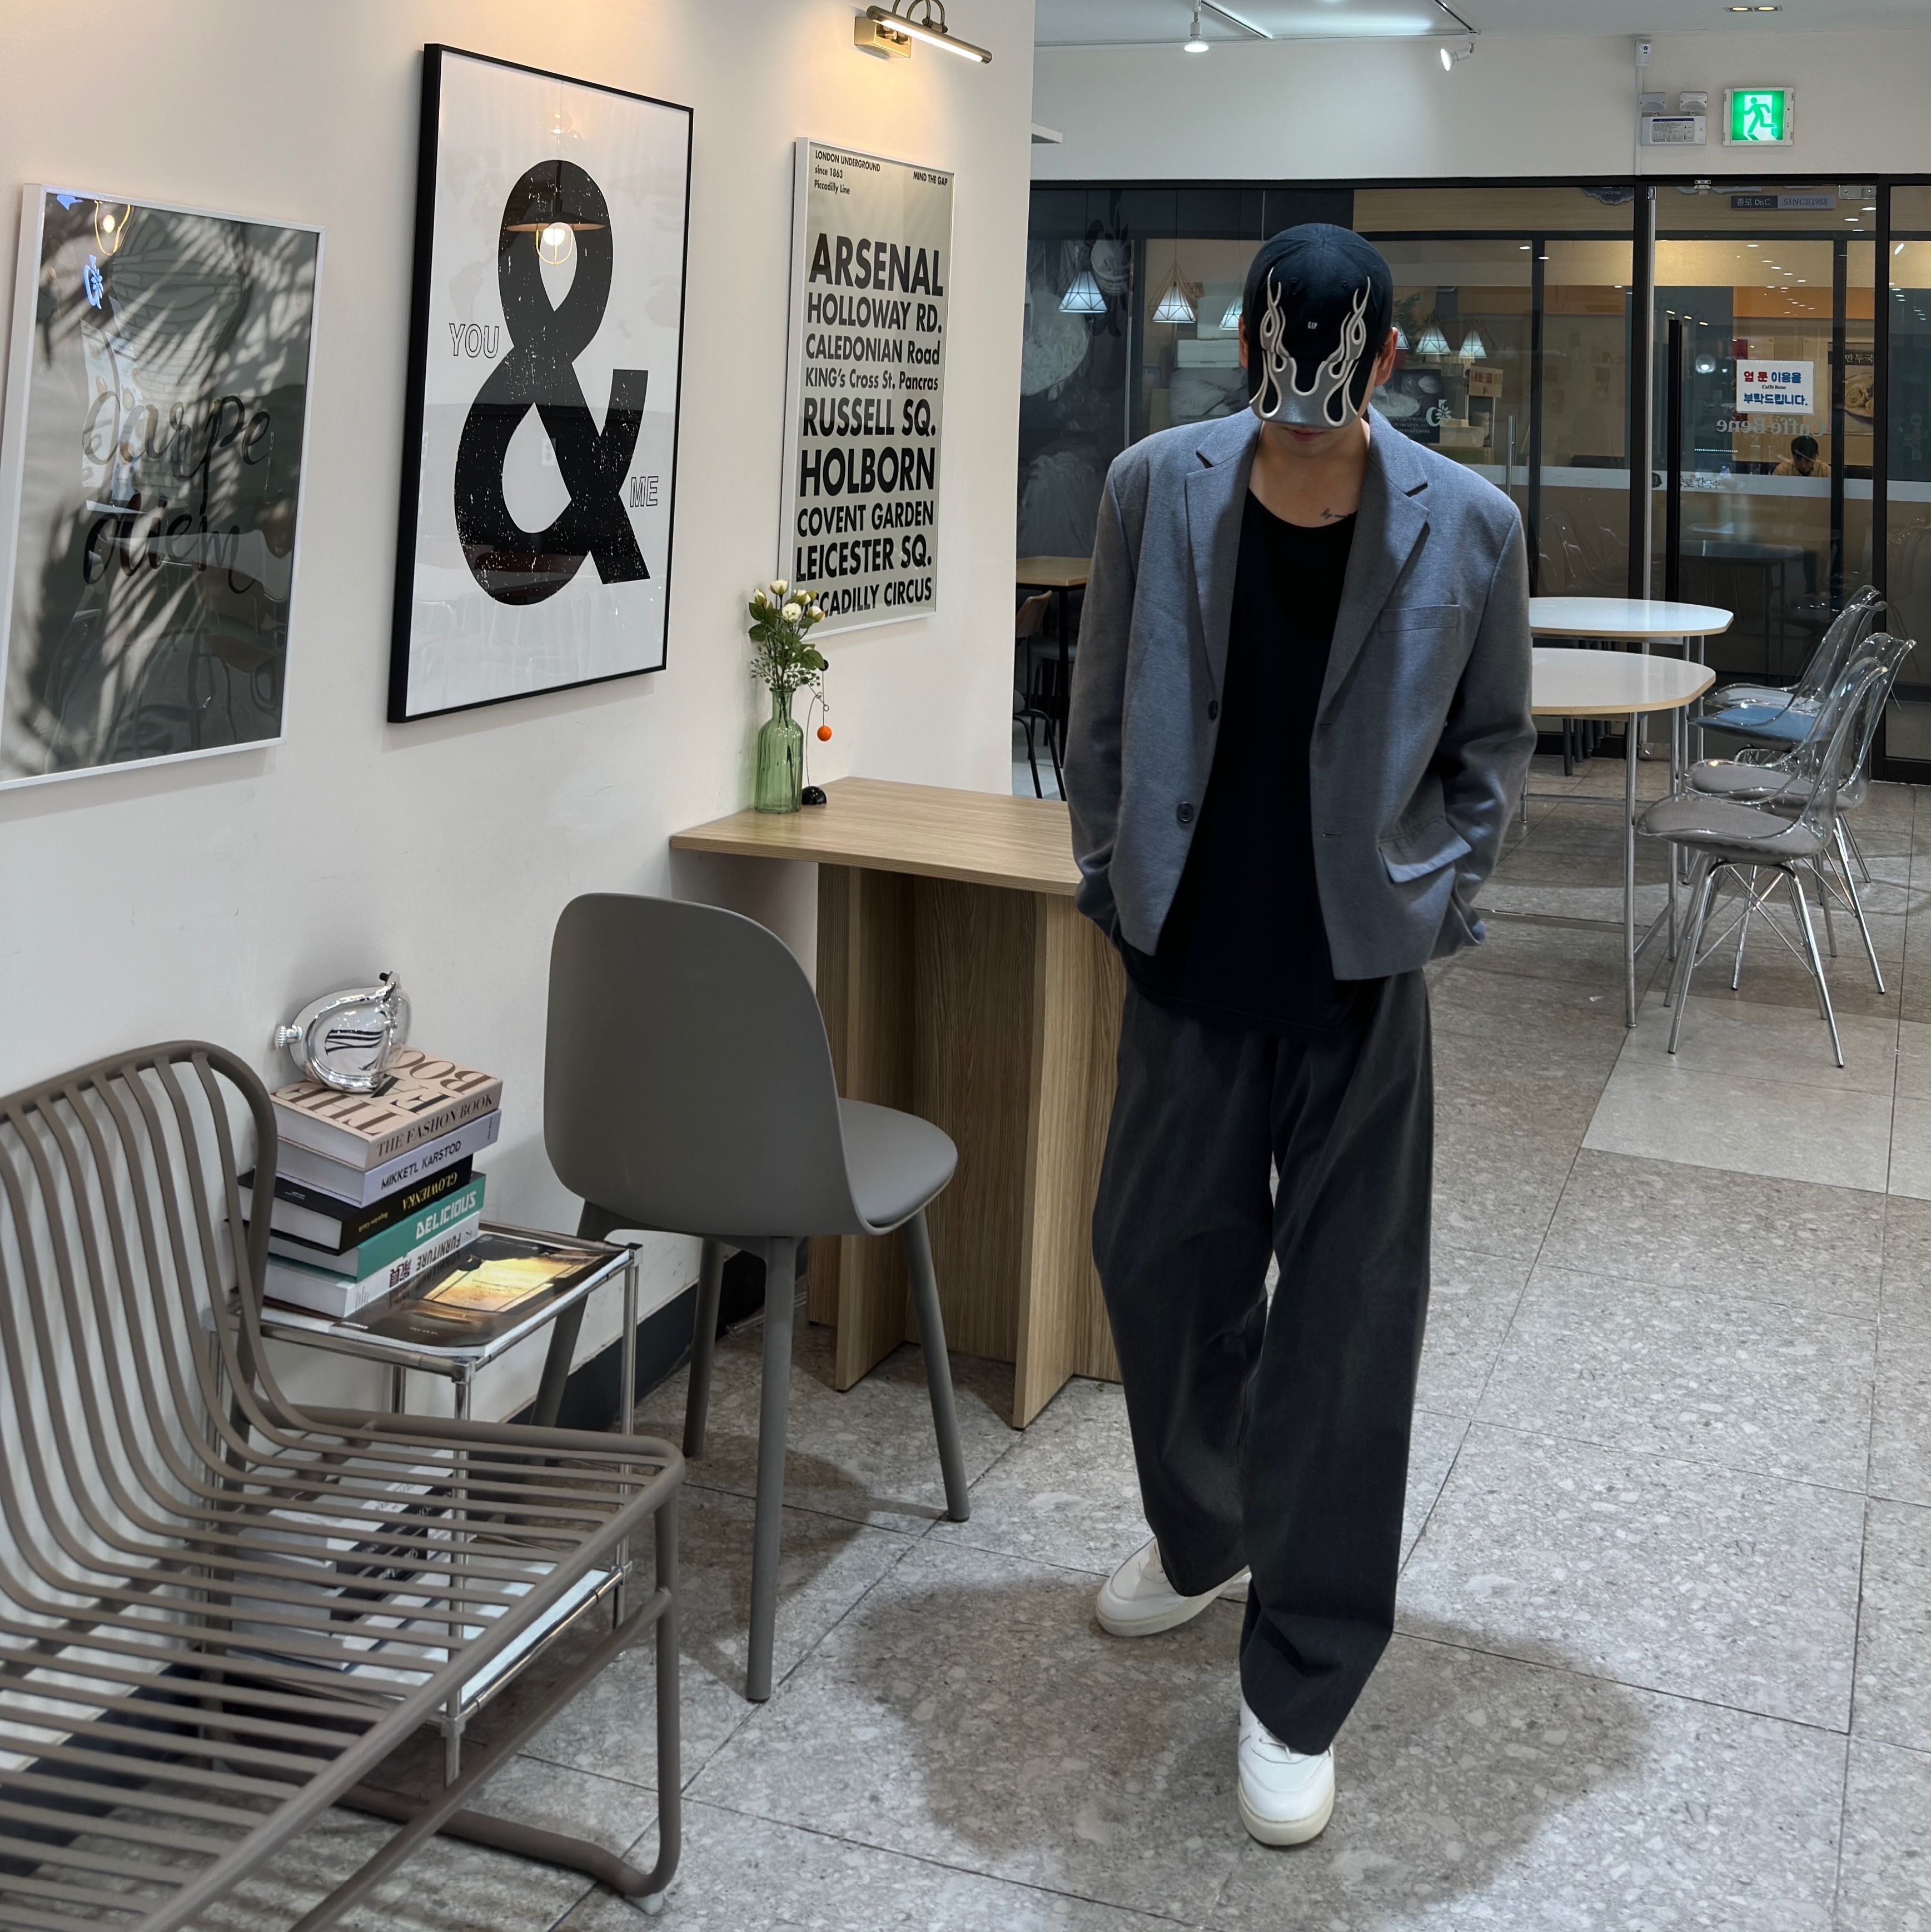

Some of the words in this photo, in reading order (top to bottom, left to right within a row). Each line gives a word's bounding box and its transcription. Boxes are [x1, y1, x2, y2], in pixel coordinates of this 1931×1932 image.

[815, 150, 839, 163] LONDON
[841, 156, 881, 172] UNDERGROUND
[815, 166, 828, 176] since
[830, 168, 843, 178] 1863
[913, 171, 927, 181] MIND
[928, 174, 937, 184] THE
[937, 176, 948, 186] GAP
[814, 180, 839, 194] Piccadilly
[840, 185, 850, 194] Line
[809, 233, 944, 296] ARSENAL
[807, 292, 912, 330] HOLLOWAY
[916, 303, 943, 333] RD.
[449, 323, 500, 358] YOU
[805, 333, 903, 363] CALEDONIAN
[907, 341, 940, 365] Road
[454, 160, 650, 605] &
[805, 367, 845, 387] KING's
[849, 369, 879, 389] Cross
[882, 371, 896, 390] St.
[899, 371, 939, 391] Pancras
[1743, 371, 1754, 382] 옆
[1757, 371, 1768, 382] 문
[1771, 371, 1801, 384] 이용을
[1743, 392, 1808, 406] 부탁드립니다.
[803, 397, 895, 437] RUSSELL
[902, 399, 936, 437] SQ.
[799, 446, 935, 497] HOLBORN
[630, 476, 659, 507] ME
[797, 504, 866, 537] COVENT
[871, 500, 934, 531] GARDEN
[796, 537, 894, 582] LEICESTER
[900, 534, 932, 569] SQ.
[884, 577, 932, 606] CIRCUS
[377, 1132, 402, 1157] THE
[407, 1111, 457, 1144] FASHION
[459, 1093, 493, 1119] BOOK
[415, 1190, 477, 1240] DELICIOUS
[416, 1232, 461, 1271] FURNITURE
